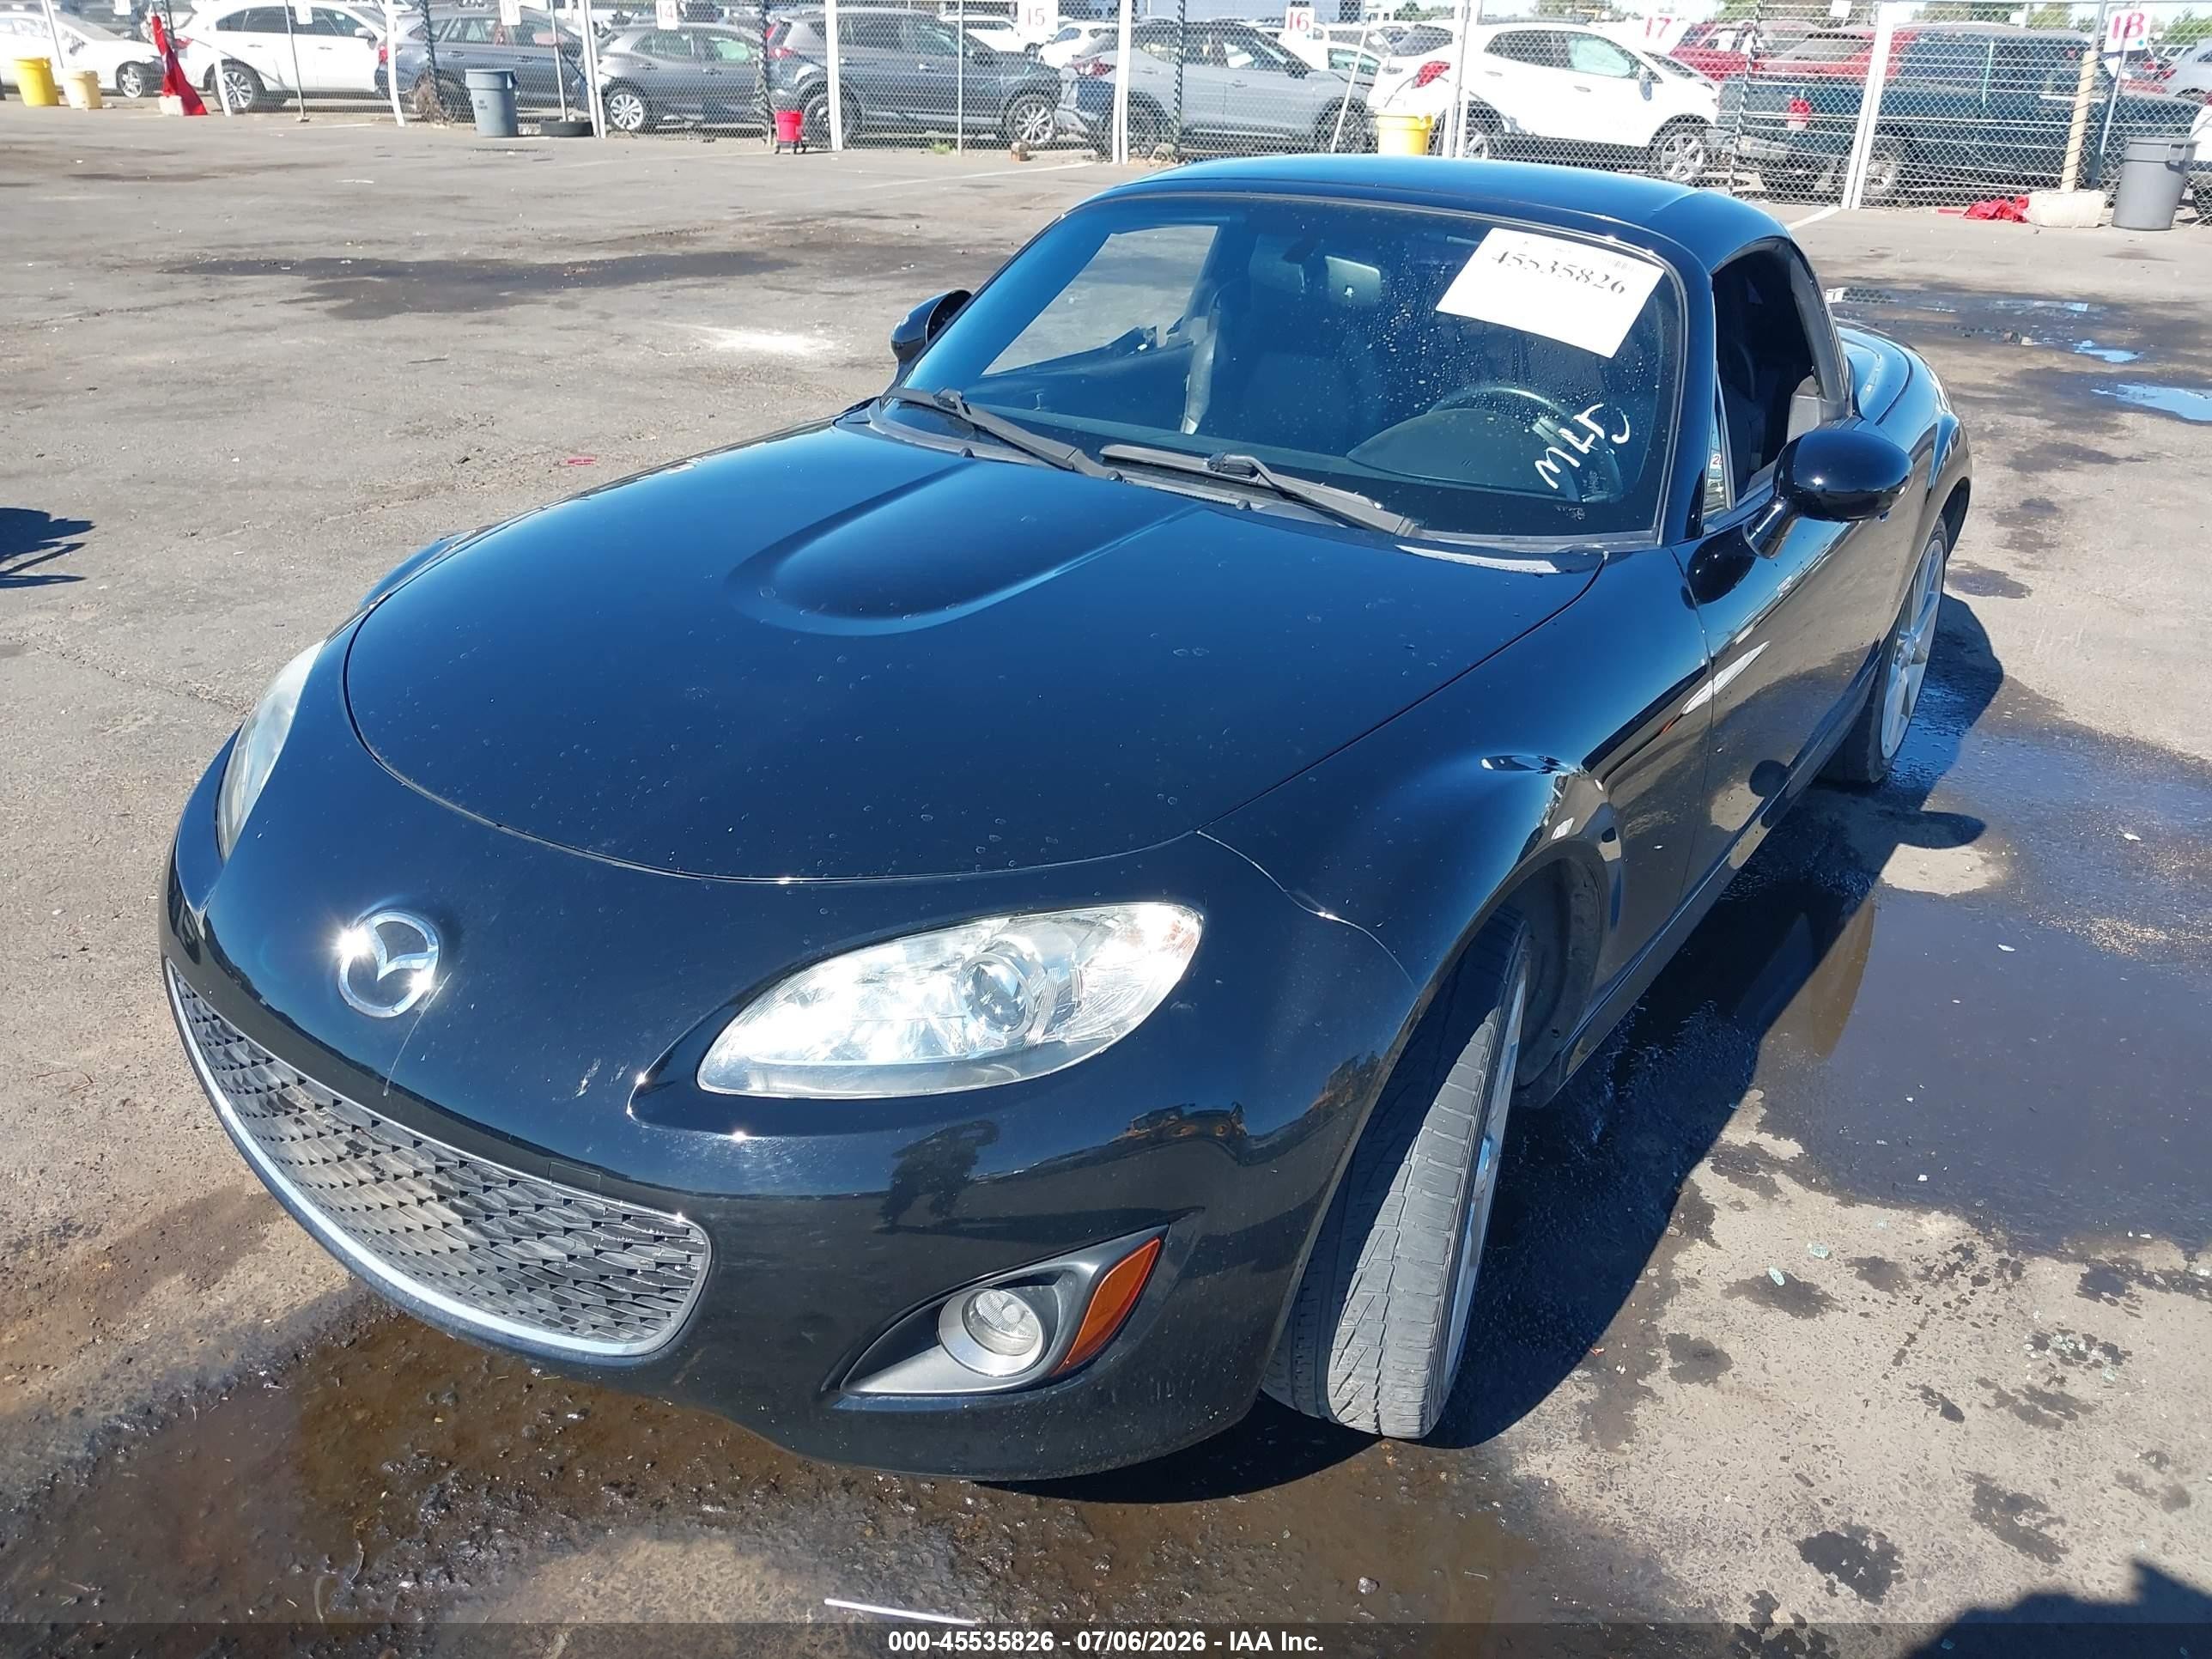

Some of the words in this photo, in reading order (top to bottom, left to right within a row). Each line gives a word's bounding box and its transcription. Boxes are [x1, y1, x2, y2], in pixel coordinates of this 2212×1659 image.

[659, 3, 674, 19] 14
[1028, 7, 1045, 27] 15
[1289, 11, 1310, 32] 16
[1645, 17, 1672, 40] 17
[2112, 12, 2145, 40] 18
[1492, 250, 1626, 295] 45535826
